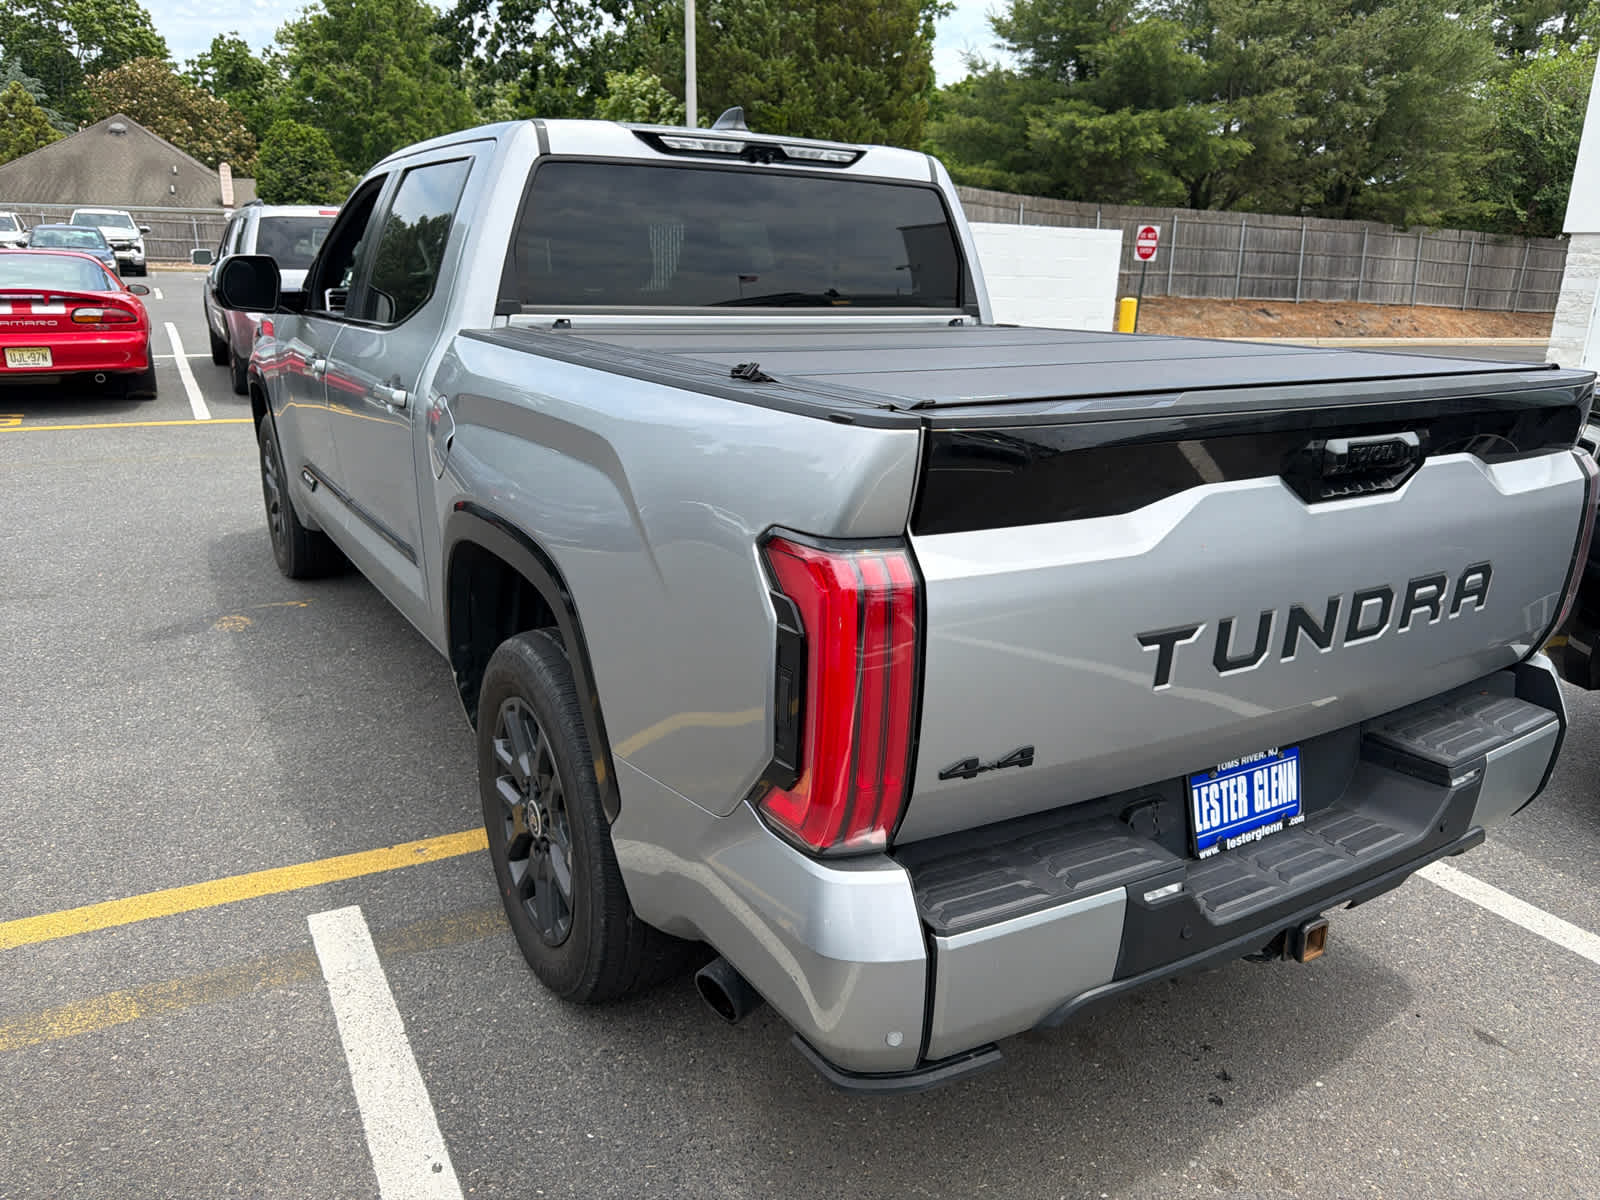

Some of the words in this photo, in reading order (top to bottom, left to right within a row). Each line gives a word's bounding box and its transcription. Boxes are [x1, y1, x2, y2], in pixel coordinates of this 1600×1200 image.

[1135, 560, 1494, 692] TUNDRA
[1192, 775, 1249, 833] LESTER
[1253, 759, 1297, 813] GLENN
